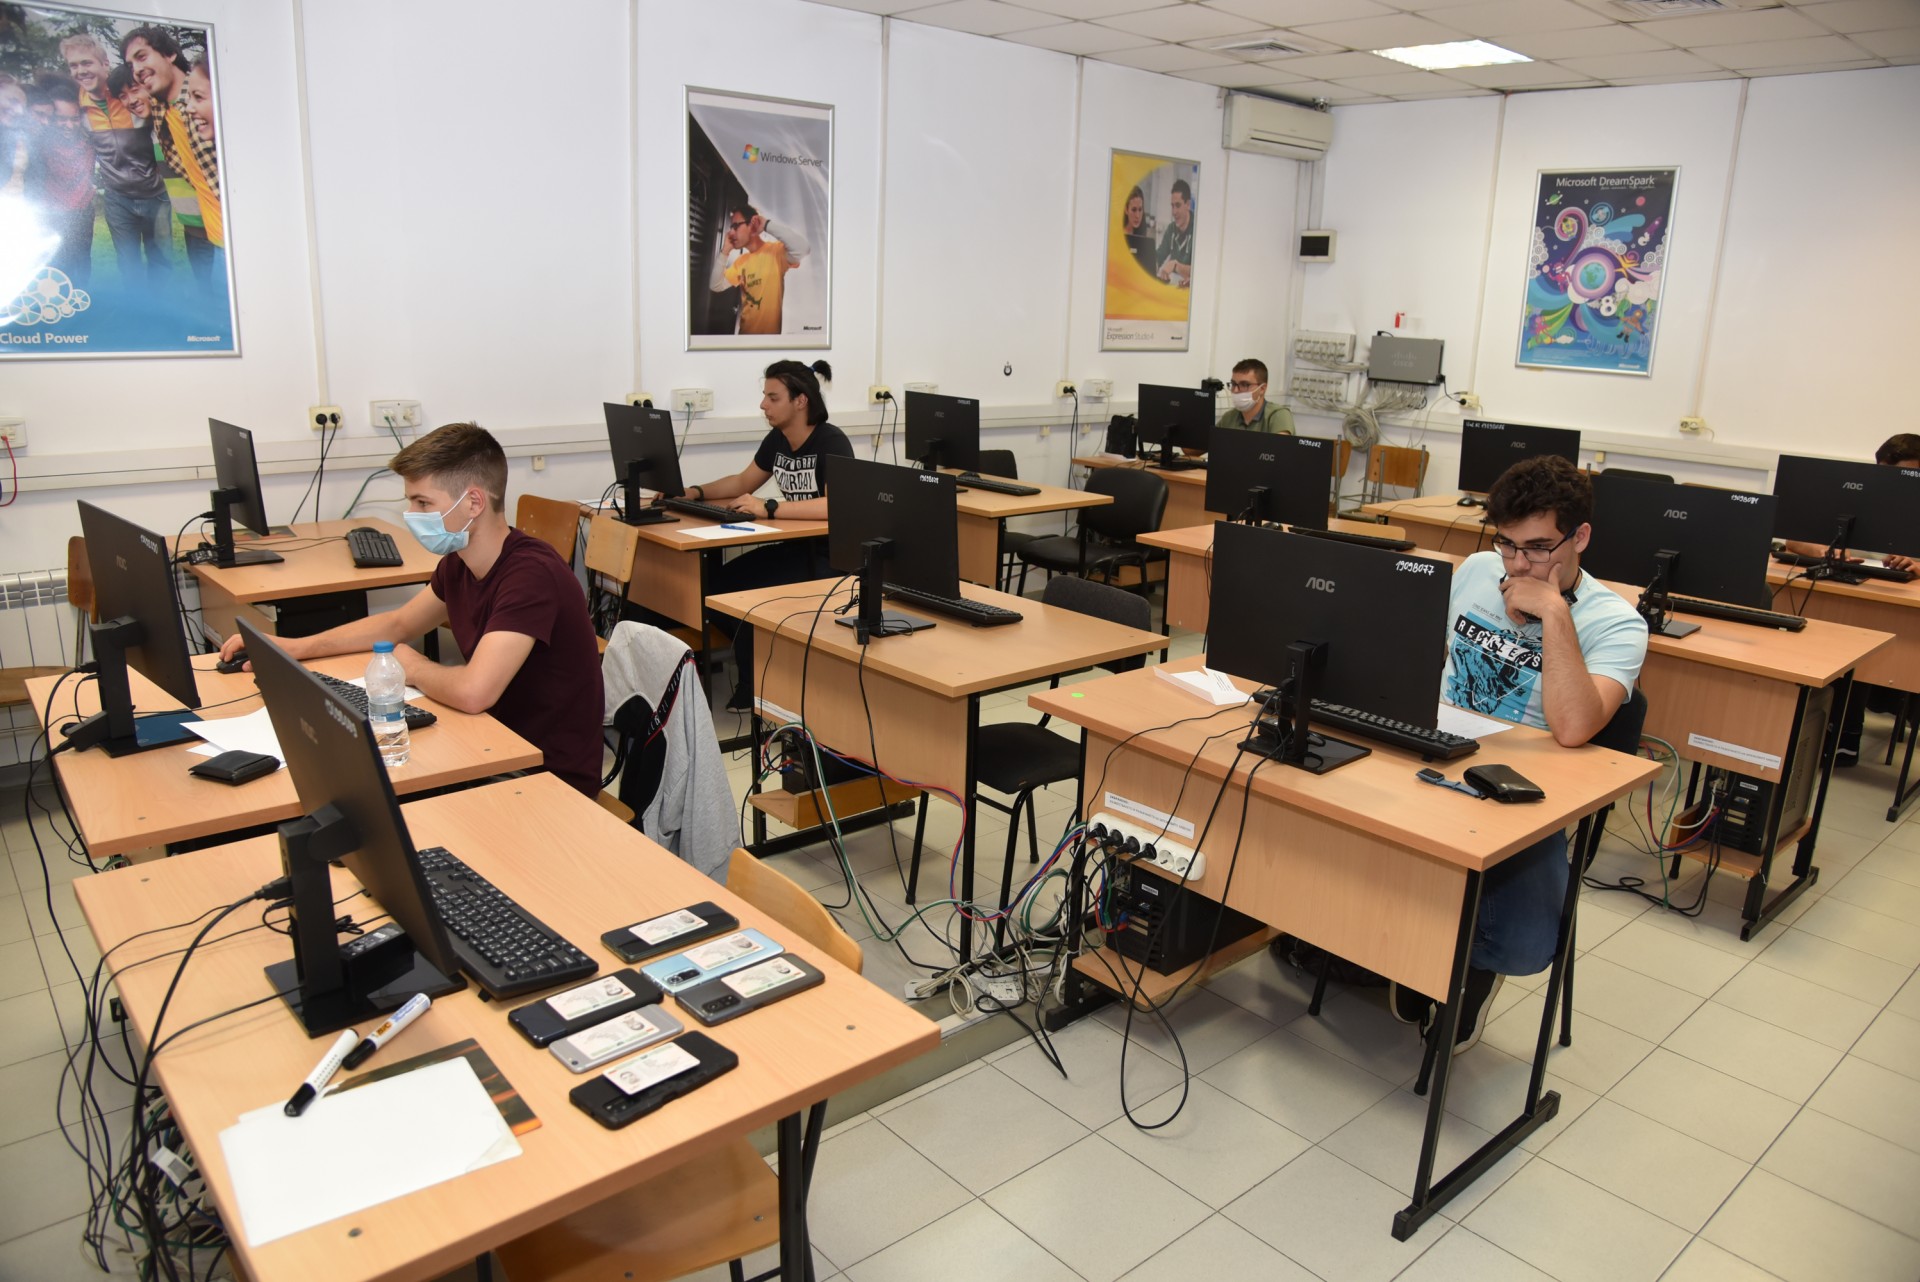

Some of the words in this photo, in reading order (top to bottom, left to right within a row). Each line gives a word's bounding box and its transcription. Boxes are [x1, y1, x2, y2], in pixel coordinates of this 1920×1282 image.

[761, 152, 797, 165] Windows
[798, 156, 824, 167] Server
[1556, 176, 1597, 187] Microsoft
[1599, 175, 1655, 188] DreamSpark
[0, 332, 42, 345] Cloud
[45, 332, 89, 344] Power
[1510, 441, 1526, 449] AOC
[1259, 453, 1275, 462] AOC
[1842, 481, 1864, 491] AOC
[877, 492, 894, 503] AOC
[1664, 509, 1688, 520] AOC
[1305, 577, 1335, 593] AOC
